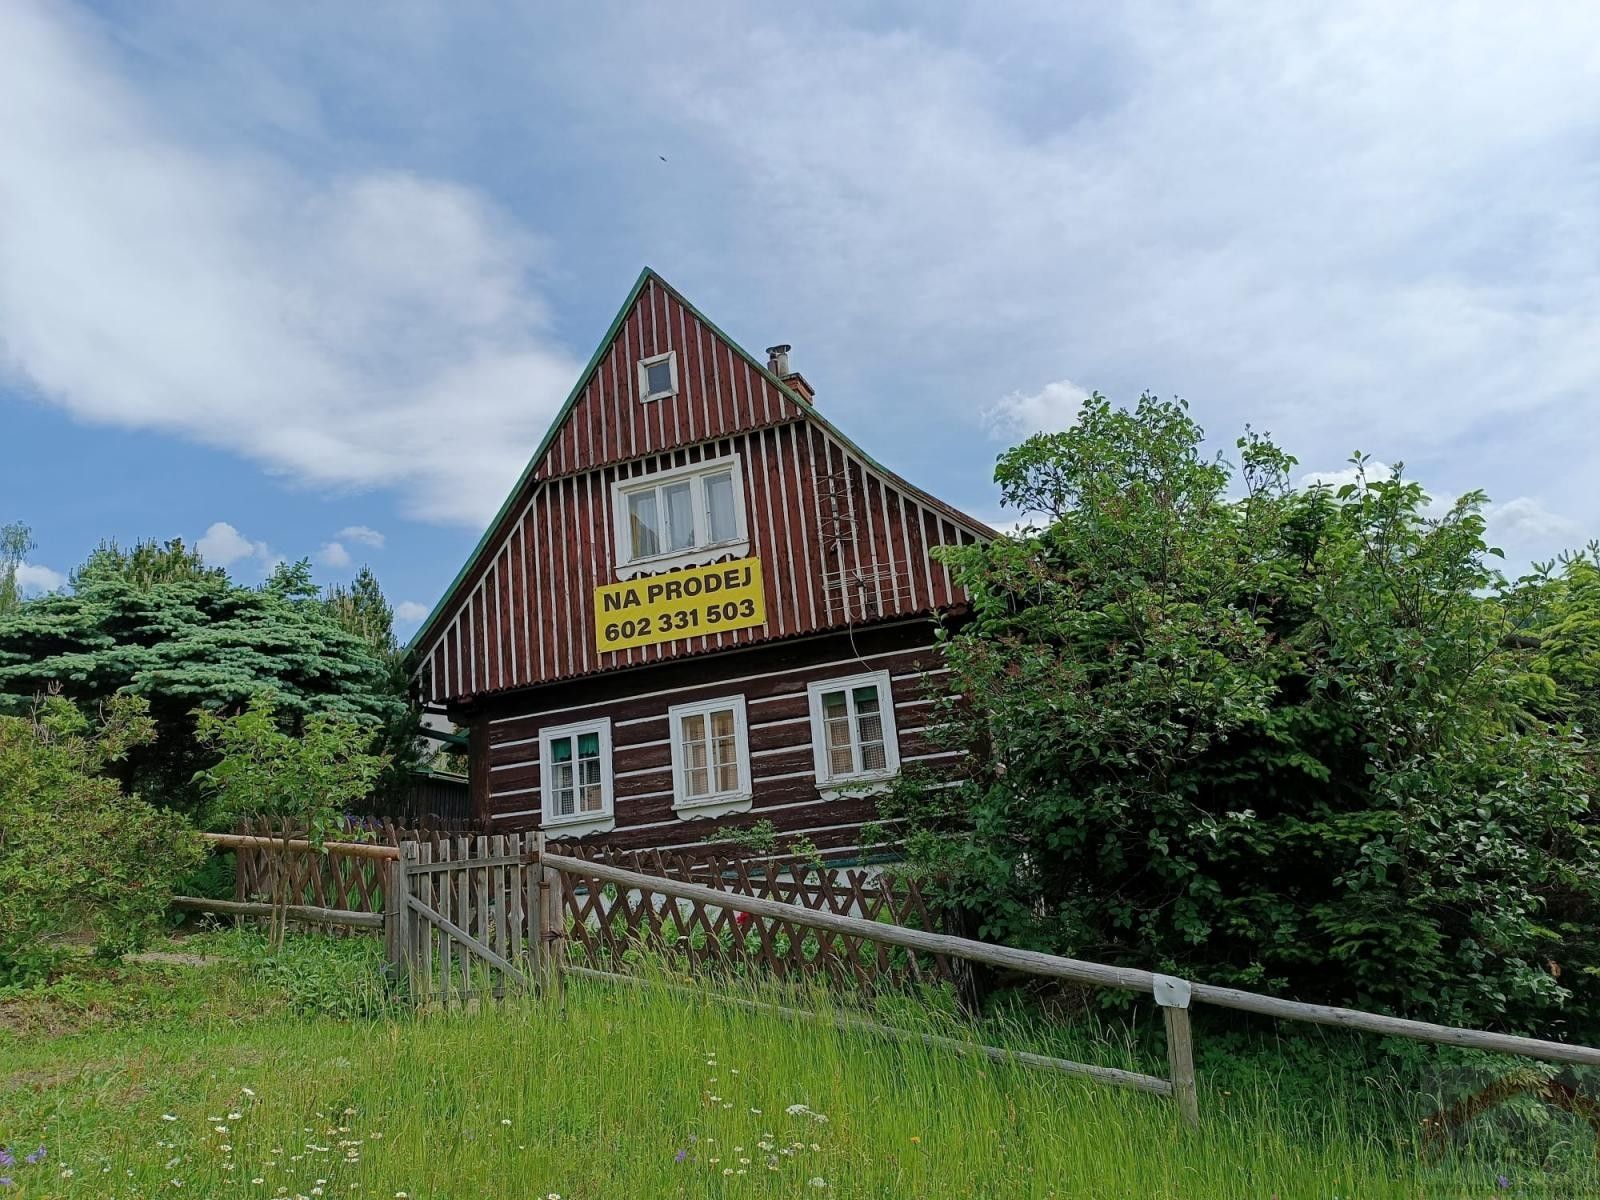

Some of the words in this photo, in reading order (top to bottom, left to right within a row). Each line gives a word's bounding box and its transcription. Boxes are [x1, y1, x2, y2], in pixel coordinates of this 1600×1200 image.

[603, 588, 642, 612] NA
[647, 566, 752, 604] PRODEJ
[604, 617, 652, 642] 602
[658, 608, 699, 632] 331
[706, 599, 755, 624] 503
